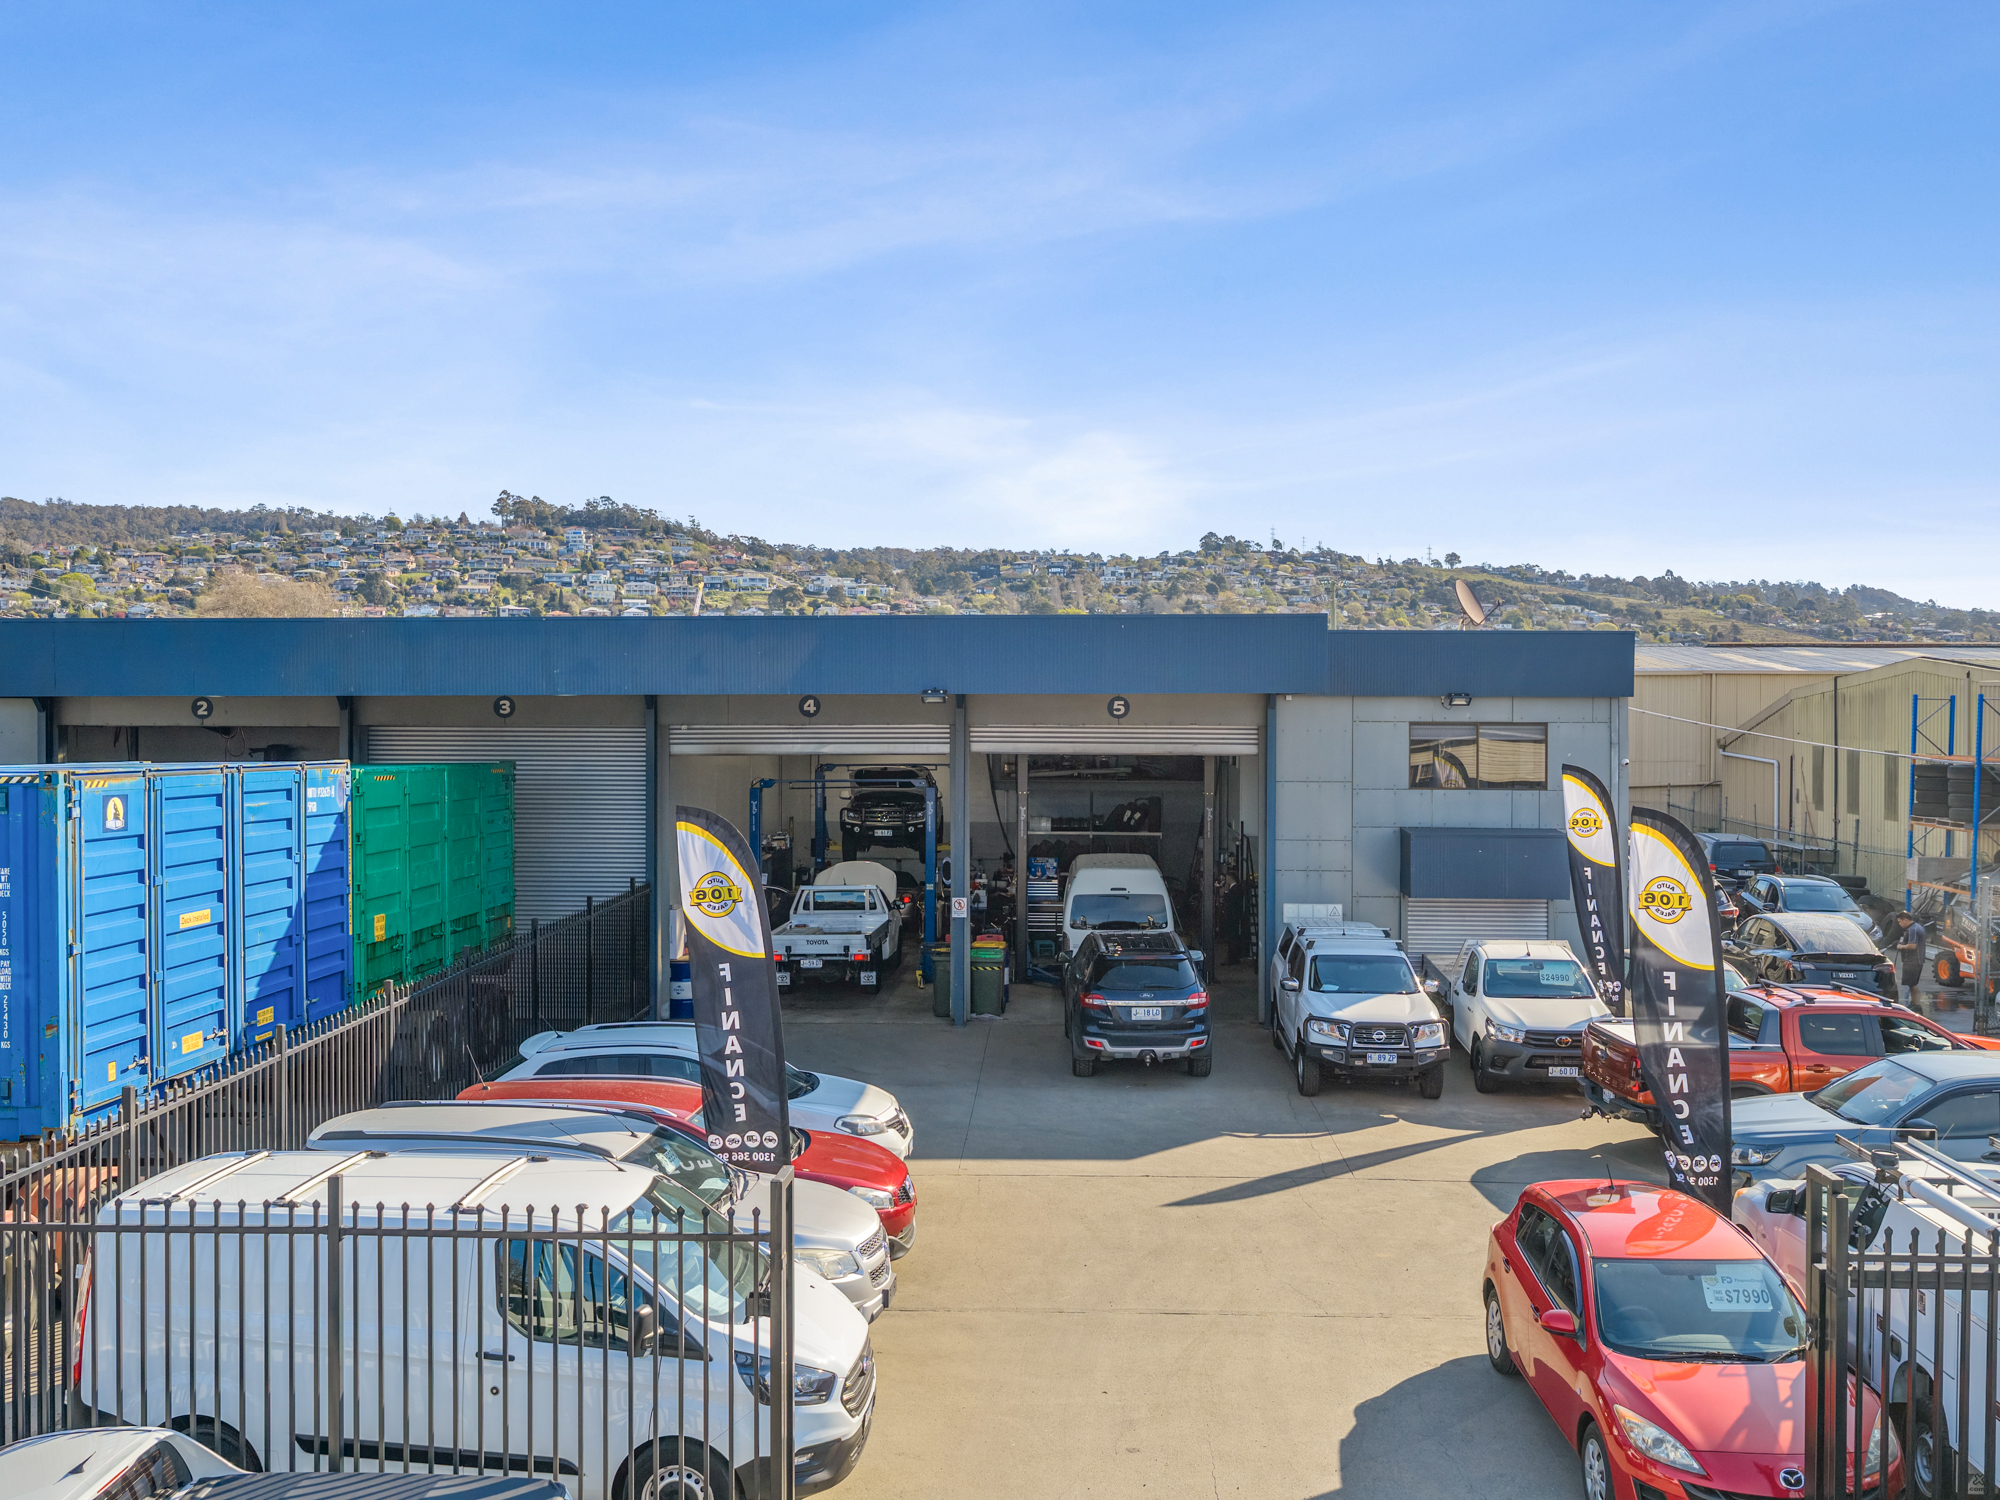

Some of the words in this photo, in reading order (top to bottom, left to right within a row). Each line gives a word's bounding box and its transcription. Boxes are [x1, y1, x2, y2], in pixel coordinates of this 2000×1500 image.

[197, 701, 207, 715] 2
[500, 700, 510, 714] 3
[804, 700, 816, 713] 4
[1113, 700, 1124, 714] 5
[1725, 1289, 1769, 1304] $7990
